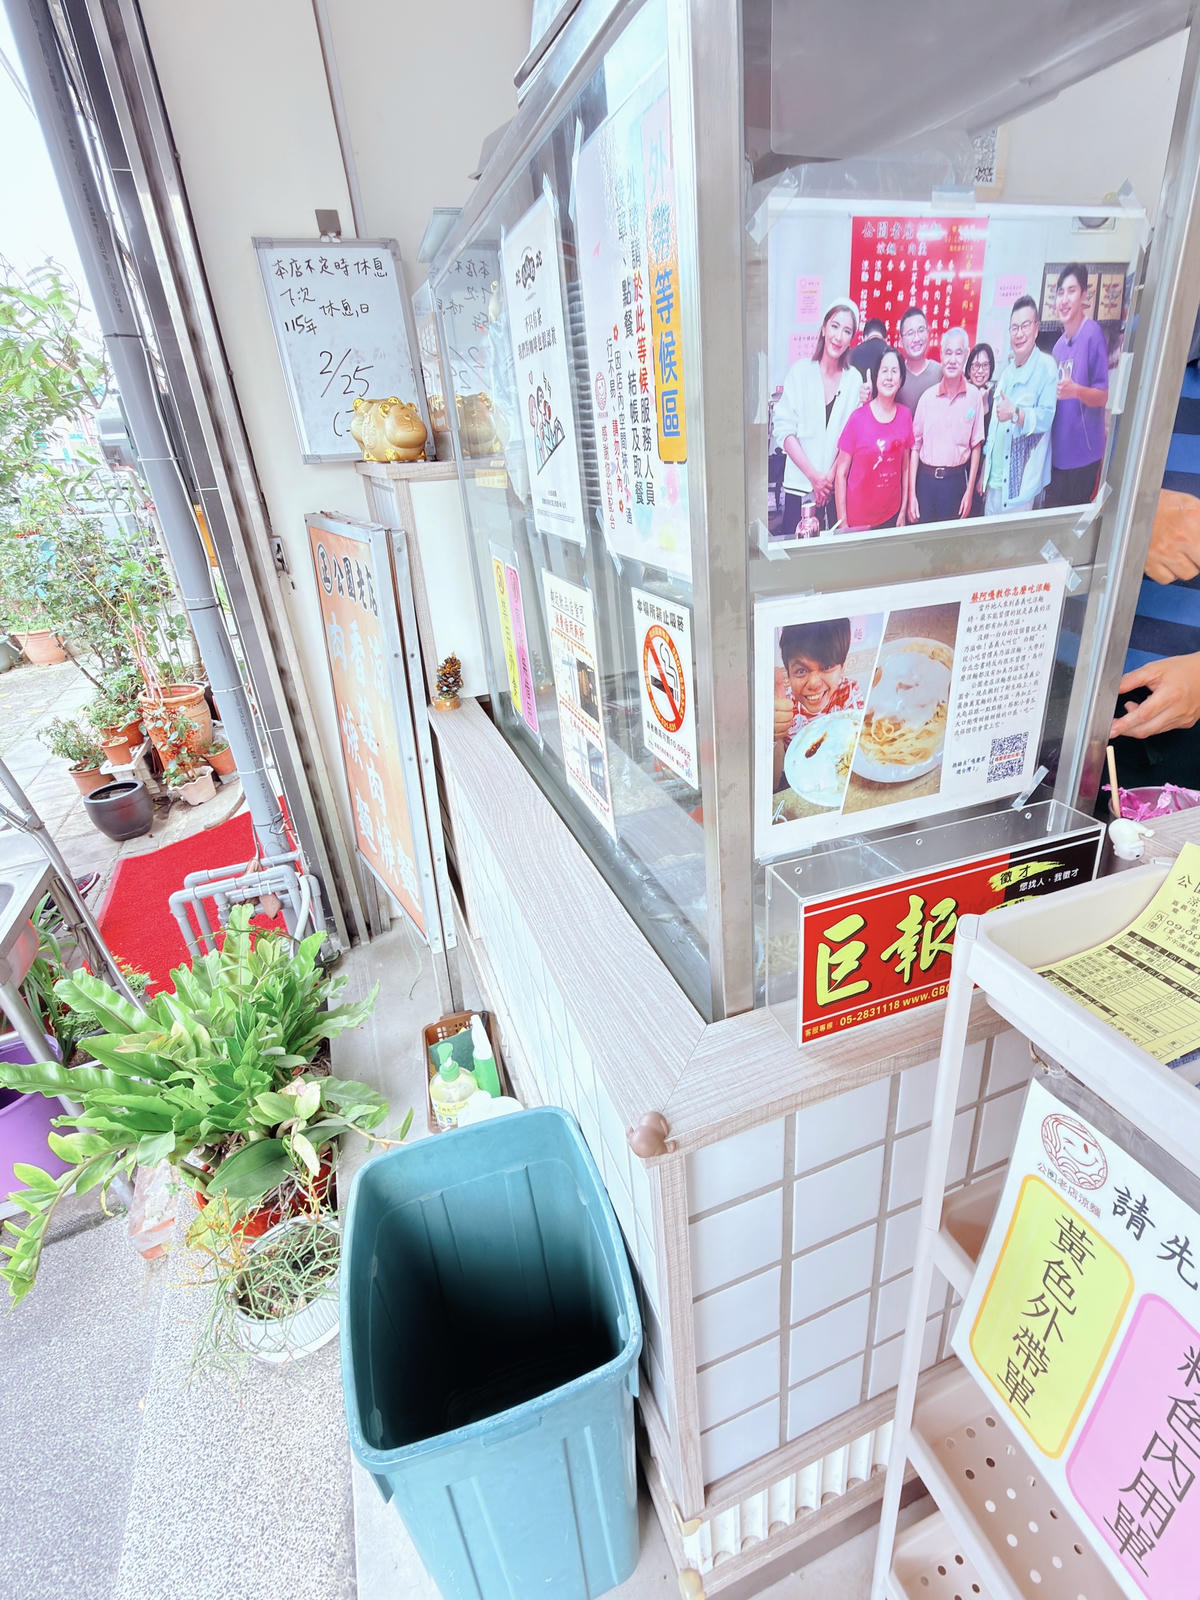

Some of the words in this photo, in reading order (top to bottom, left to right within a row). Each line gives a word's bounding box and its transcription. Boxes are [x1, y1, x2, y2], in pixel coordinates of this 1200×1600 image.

[272, 256, 388, 279] 本店不定時休息
[649, 130, 680, 437] 外帶等候區
[284, 315, 317, 335] 115年
[320, 348, 374, 398] 2/25
[637, 598, 684, 633] 本場所禁止吸菸
[1000, 865, 1031, 885] 徵才
[816, 894, 956, 1006] 巨報
[839, 1000, 900, 1027] 05-2831118
[1112, 1186, 1198, 1291] 請先
[996, 1213, 1096, 1418] 黃色外帶單
